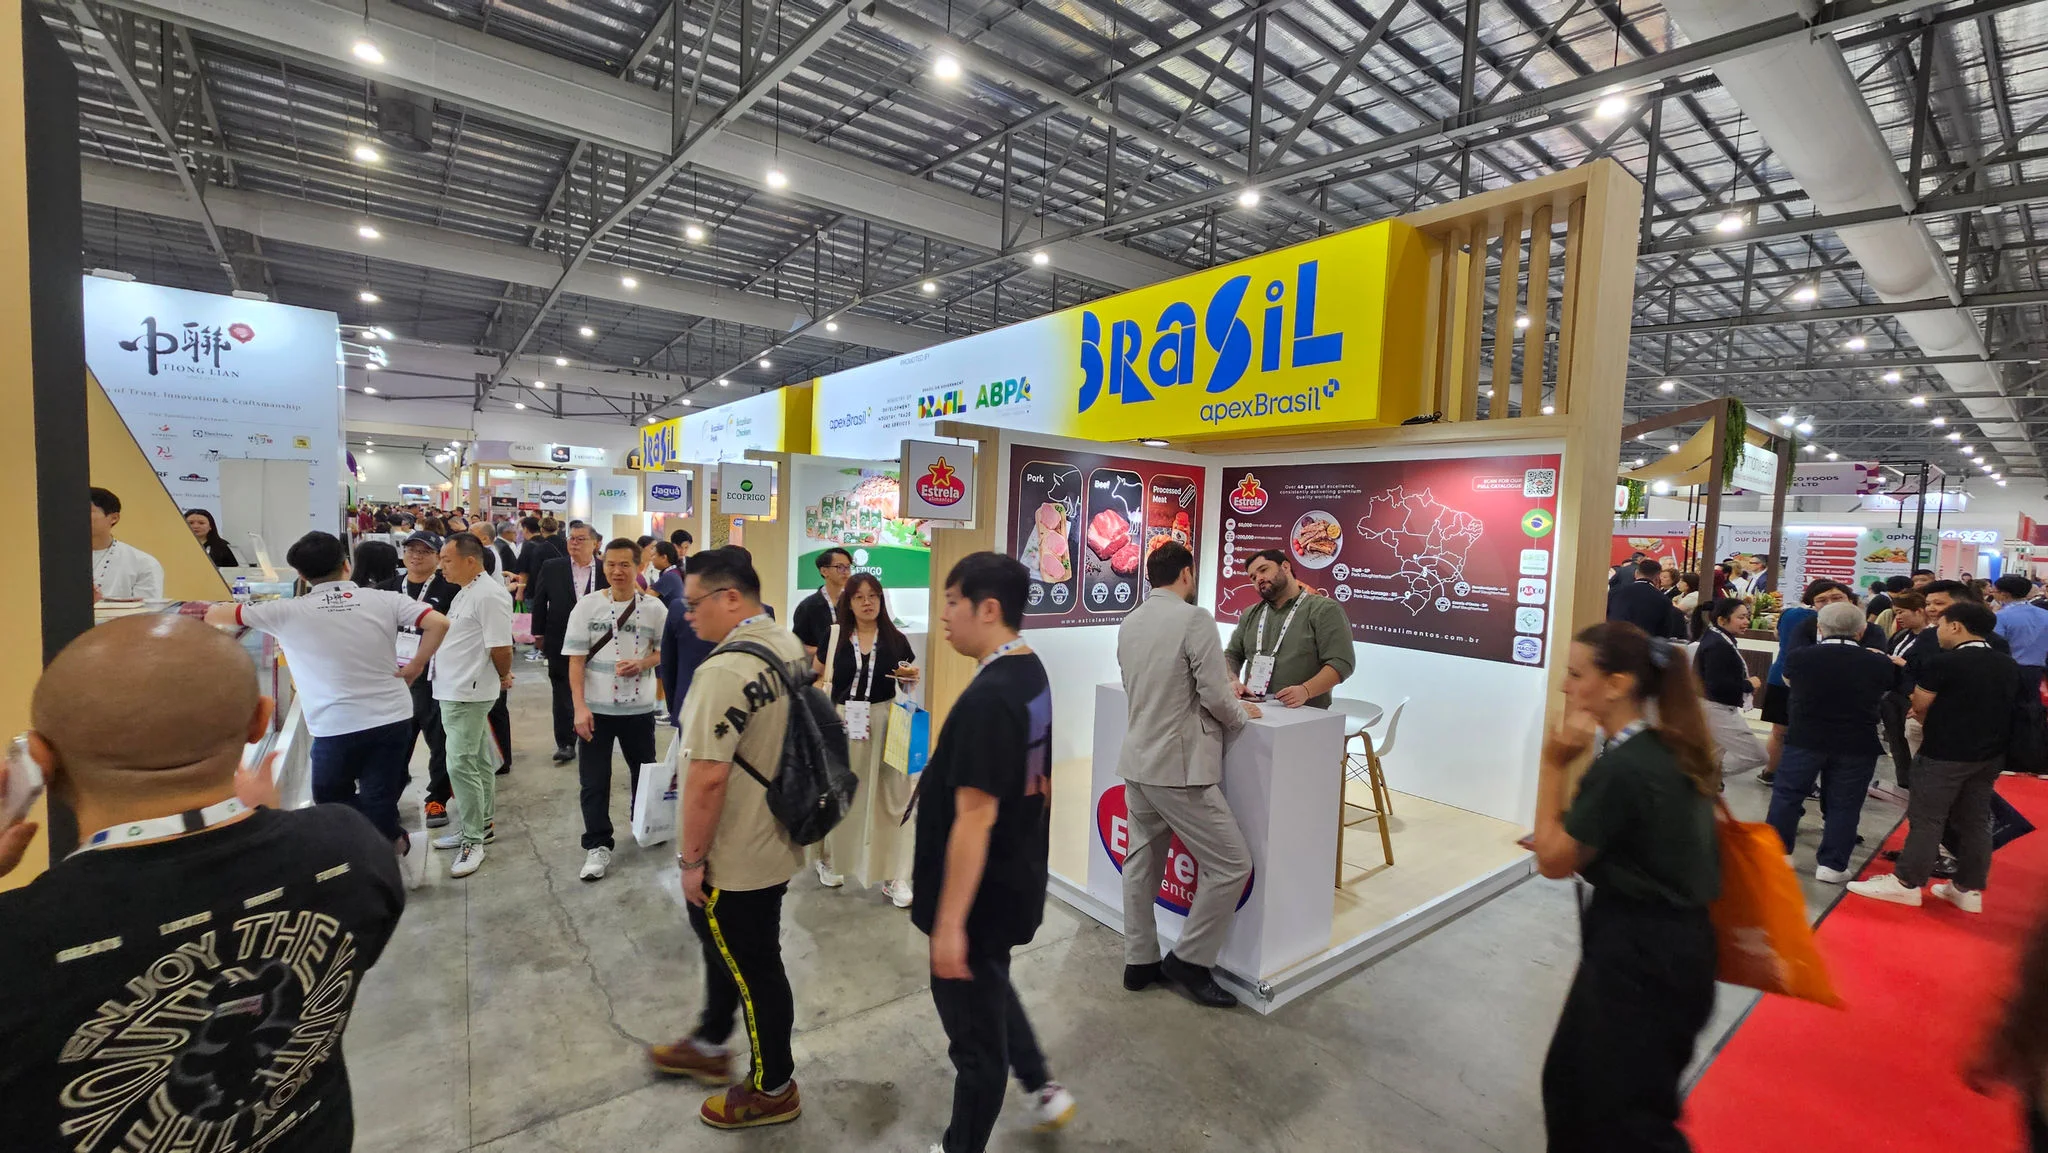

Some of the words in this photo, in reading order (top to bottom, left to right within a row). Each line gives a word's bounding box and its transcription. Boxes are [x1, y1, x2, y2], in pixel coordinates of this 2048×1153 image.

[164, 364, 204, 374] TIONG
[211, 369, 239, 378] LIAN
[975, 376, 1032, 409] ABPA
[129, 388, 159, 398] Trust,
[164, 391, 219, 403] Innovation
[232, 398, 302, 411] Craftsmanship
[1200, 388, 1320, 425] apexBrasil
[830, 411, 867, 431] apexBrasil
[1027, 474, 1044, 483] Pork
[1094, 480, 1110, 489] Beef
[652, 486, 680, 497] Jaguá
[922, 485, 959, 498] Estrela
[1153, 486, 1182, 495] Processed
[727, 492, 766, 502] ECOFRIGO
[1153, 496, 1167, 504] Meat
[1234, 497, 1262, 506] Estrela
[58, 930, 220, 1064] ENJOY
[232, 910, 341, 996] THE
